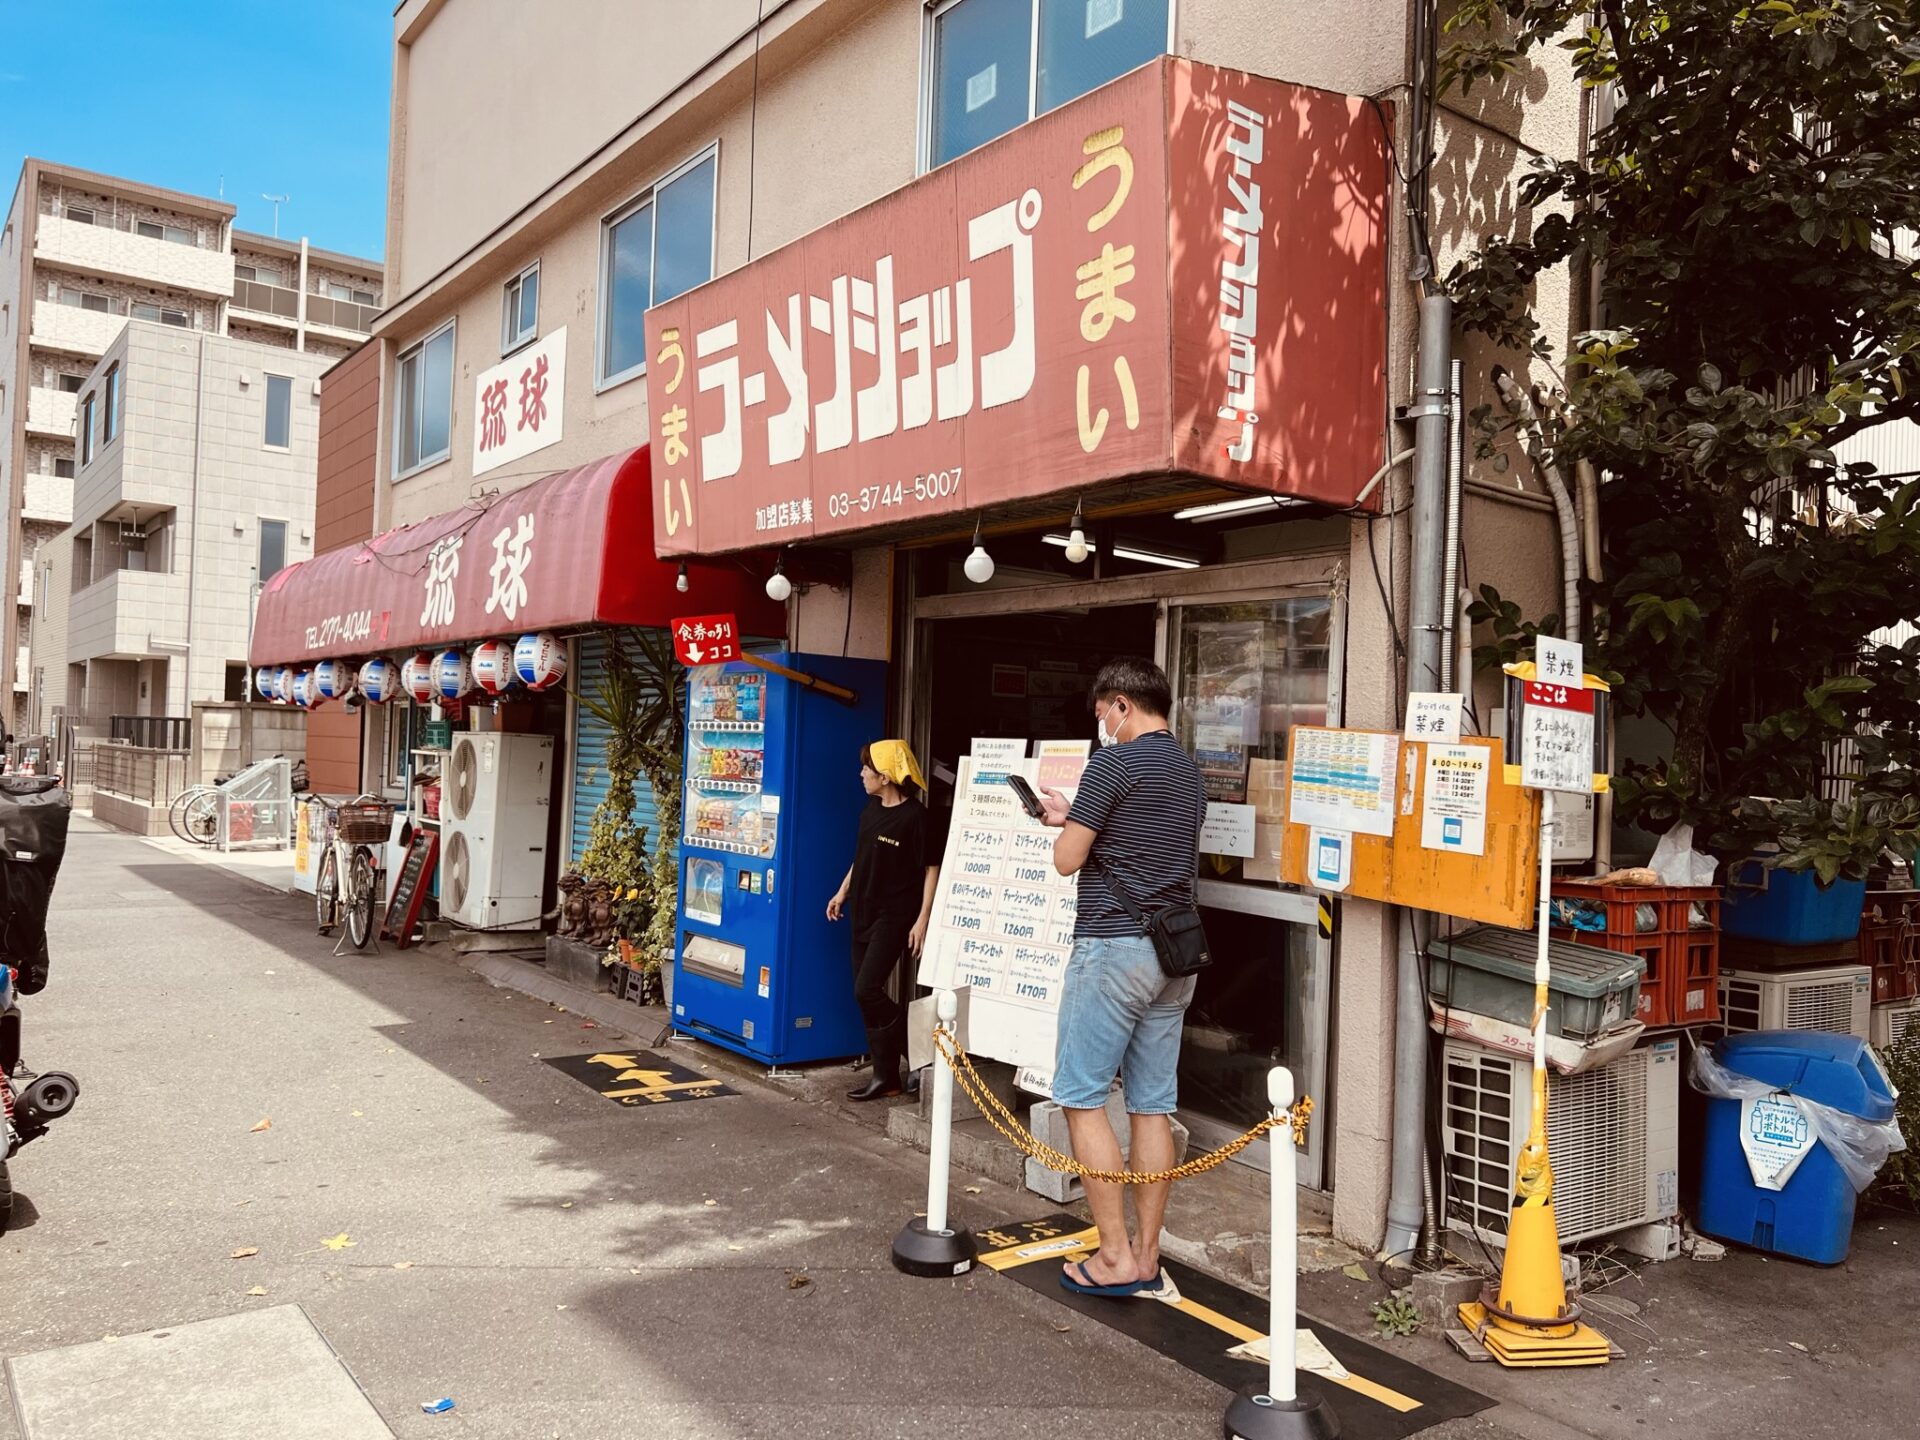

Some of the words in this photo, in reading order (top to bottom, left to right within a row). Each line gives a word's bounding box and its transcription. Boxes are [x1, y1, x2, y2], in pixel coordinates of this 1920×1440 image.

[1071, 127, 1139, 453] うまい
[1217, 99, 1264, 463] ラーメンショップ
[697, 188, 1042, 483] ラーメンショップ
[479, 352, 549, 453] 琉球
[657, 328, 693, 537] うまい
[829, 467, 963, 517] 03-3744-5007
[755, 498, 814, 532] 加盟店募集
[420, 513, 534, 627] 琉球
[319, 609, 371, 648] 277-4044
[678, 622, 732, 642] 食券の列
[710, 645, 732, 660] ココ
[1545, 650, 1575, 677] 禁煙
[1532, 683, 1567, 703] ここは
[1416, 714, 1445, 733] 禁煙
[963, 830, 1004, 846] ラーメンセット
[1014, 833, 1055, 851] ミソラーメンセッ
[964, 862, 991, 875] 1000円
[1015, 867, 1046, 882] 1100円
[952, 915, 981, 930] 1150円
[1003, 922, 1034, 939] 1260円
[965, 973, 991, 988] 1130円
[1016, 983, 1047, 1000] 1470円
